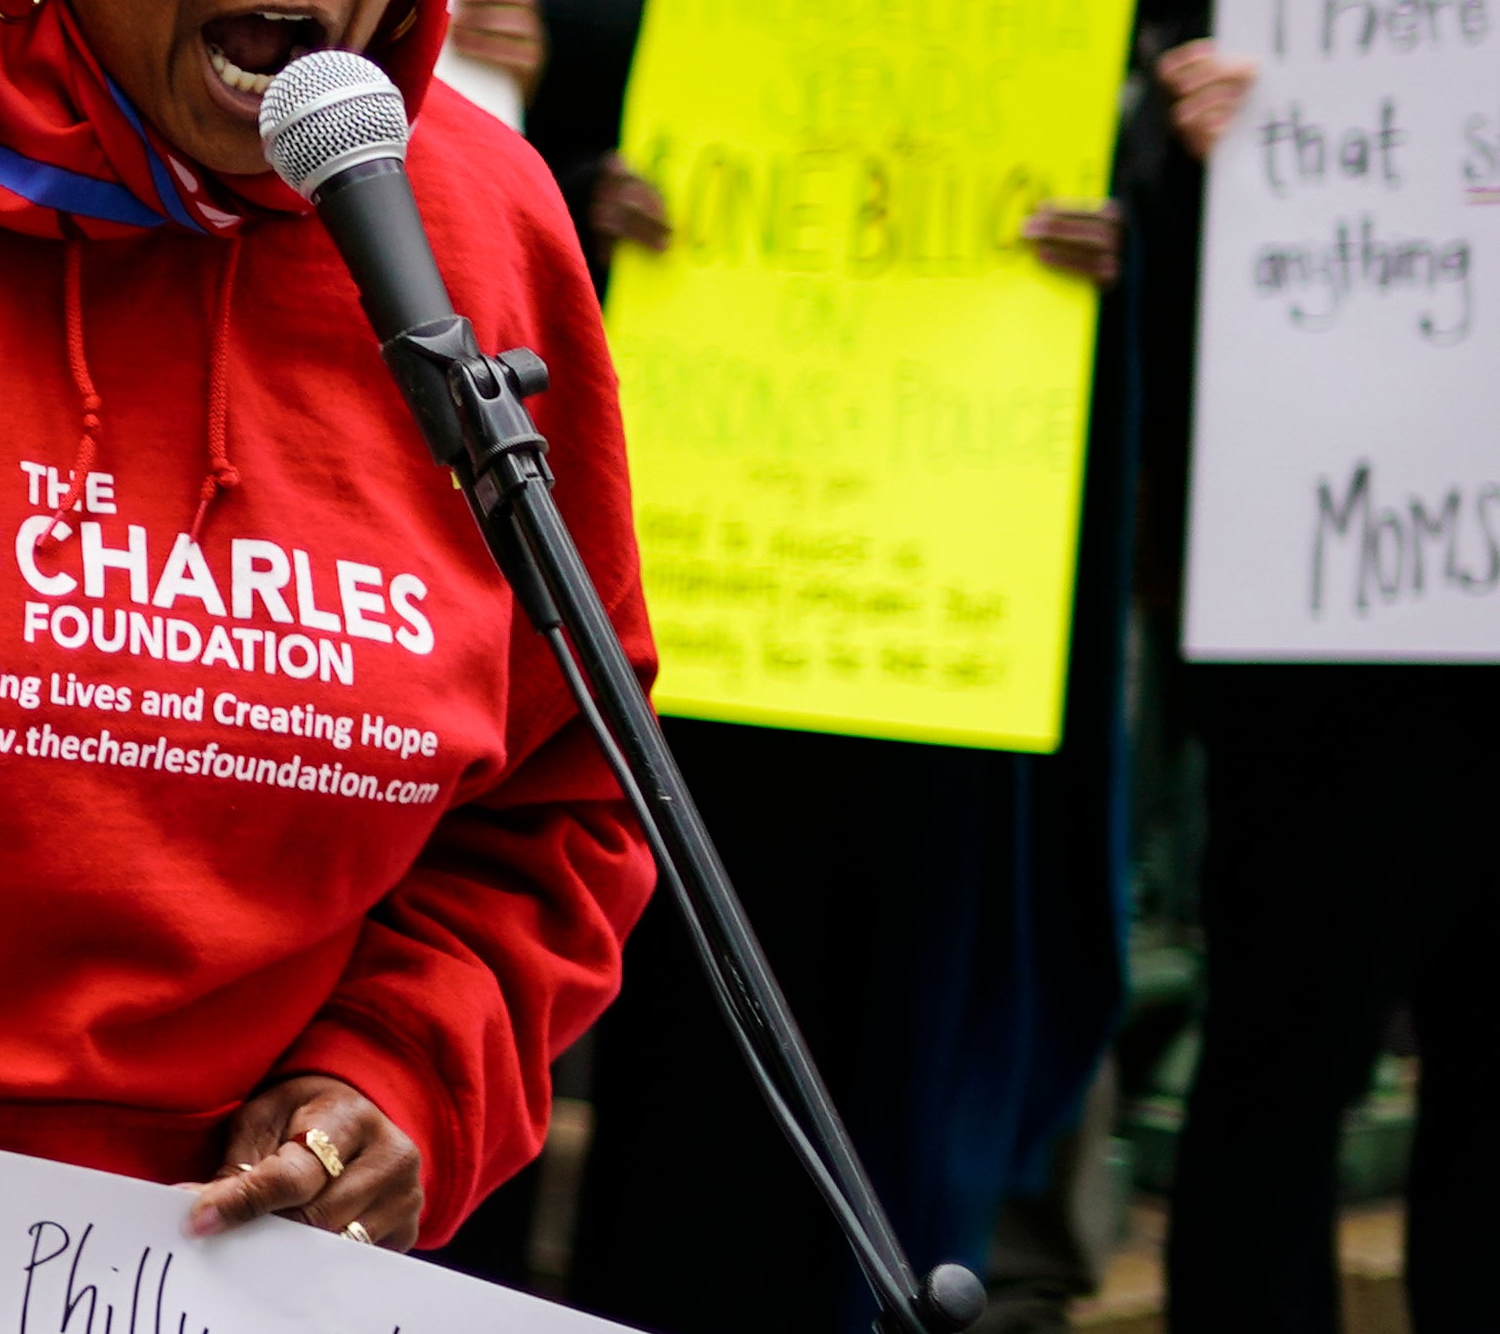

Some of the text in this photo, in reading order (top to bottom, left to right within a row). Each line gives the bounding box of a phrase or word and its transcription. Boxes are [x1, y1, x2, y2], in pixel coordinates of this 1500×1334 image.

[1257, 95, 1406, 195] that
[850, 149, 1100, 281] BILLIO
[1253, 213, 1471, 348] anything
[20, 461, 116, 515] THE
[15, 515, 435, 655] CHARLES
[24, 601, 354, 685] FOUNDATION
[50, 672, 132, 713] Lives
[141, 687, 203, 722] and
[212, 693, 352, 749] Creating
[361, 715, 438, 758] Hope
